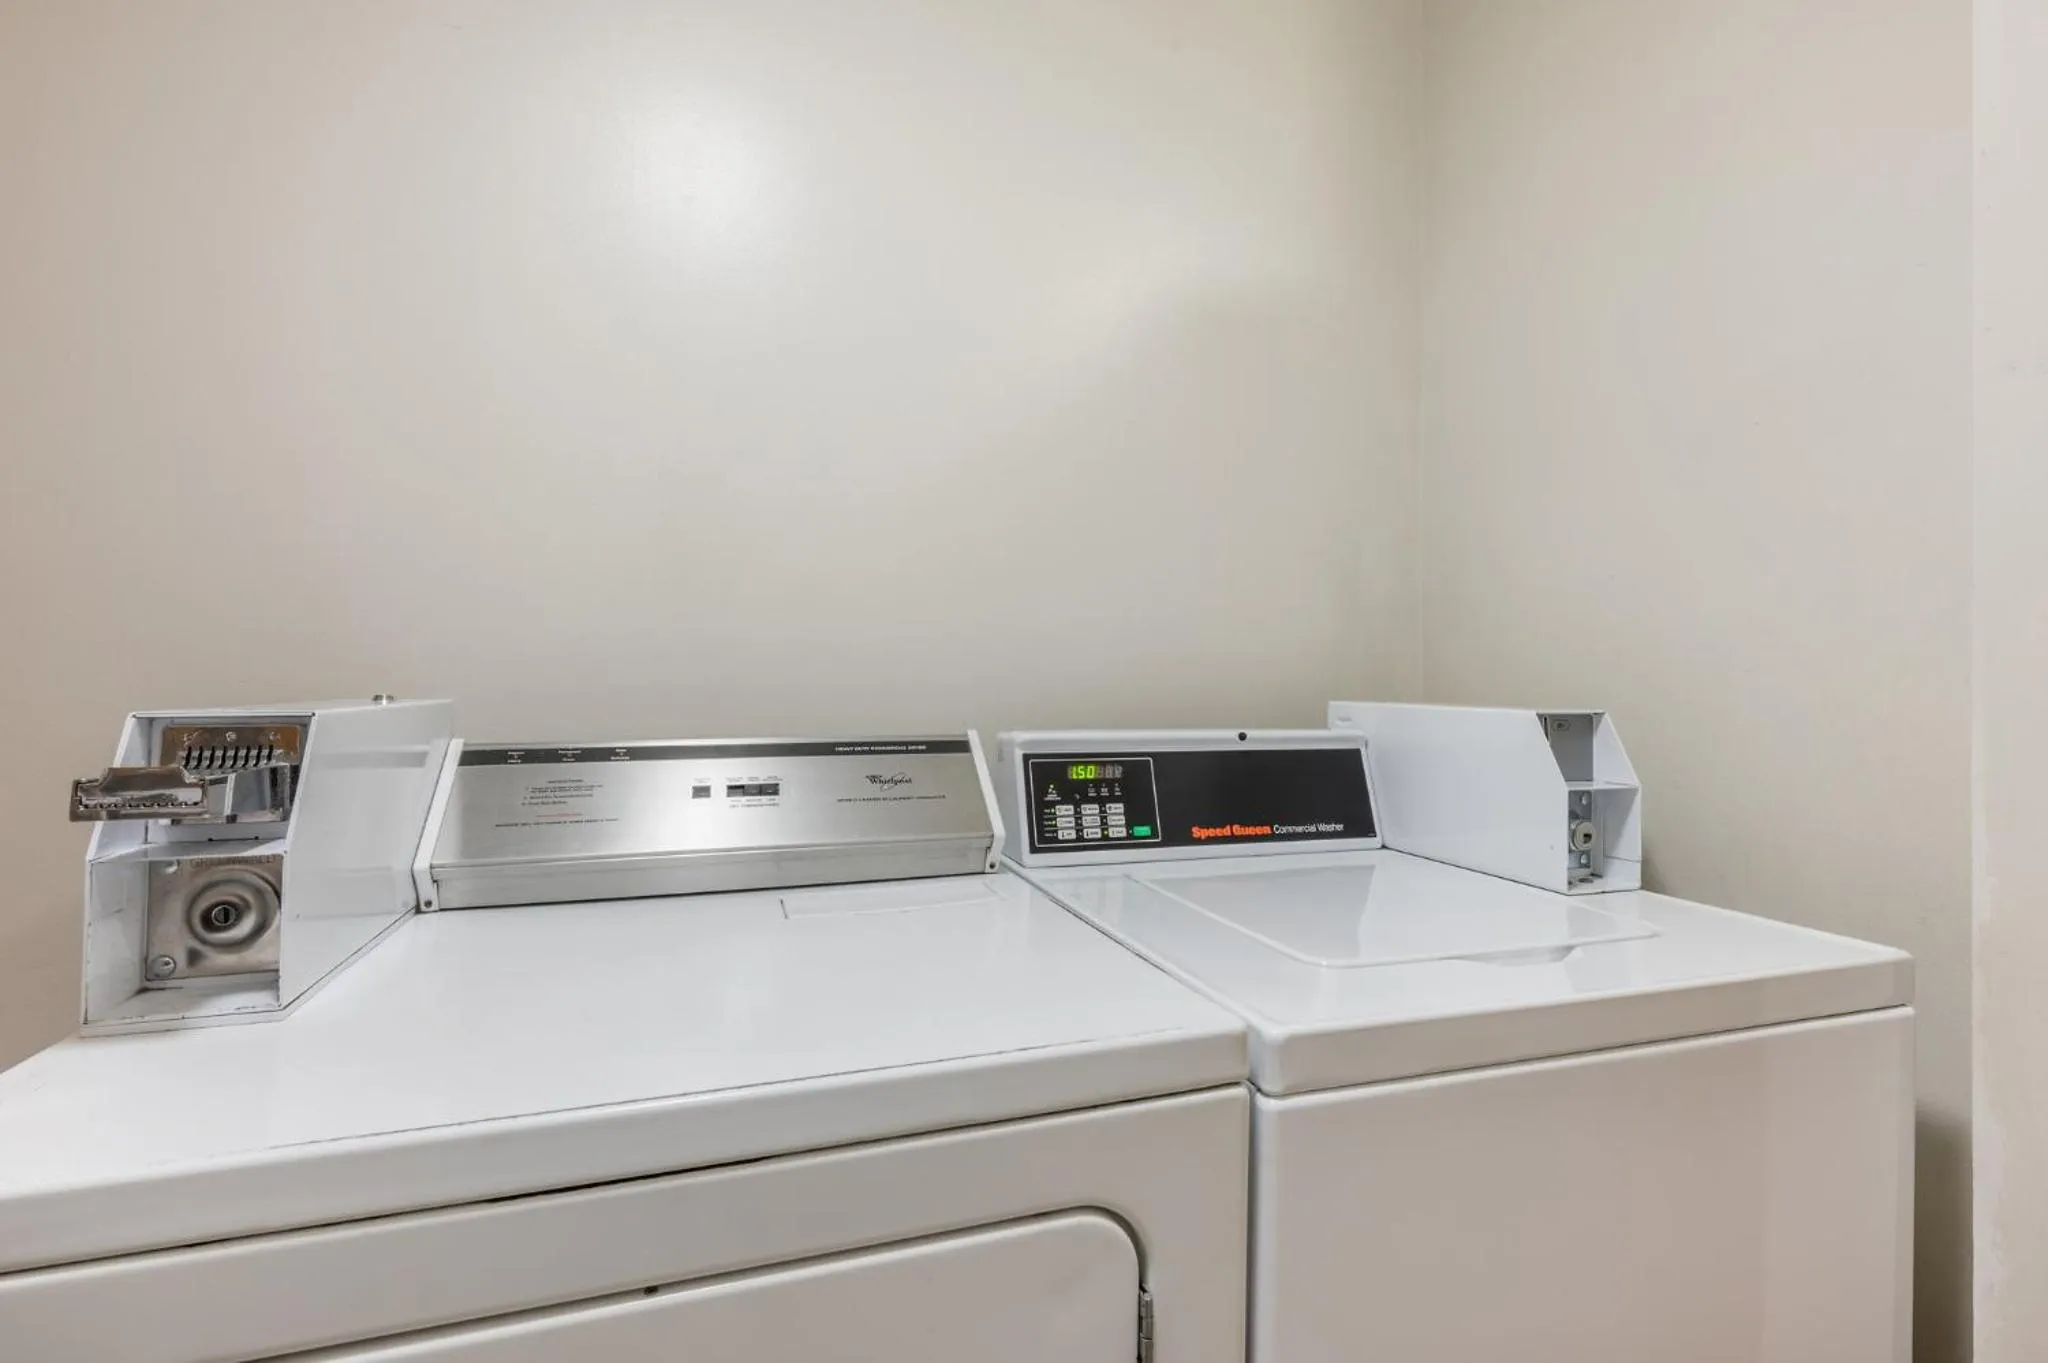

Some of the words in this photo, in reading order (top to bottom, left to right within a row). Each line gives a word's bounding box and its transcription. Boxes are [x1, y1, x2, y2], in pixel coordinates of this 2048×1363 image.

[865, 774, 913, 787] Whirlpool
[1191, 824, 1232, 840] Speed
[1232, 824, 1272, 837] Queen
[1273, 824, 1317, 834] Commercial
[1317, 823, 1344, 832] Washer
